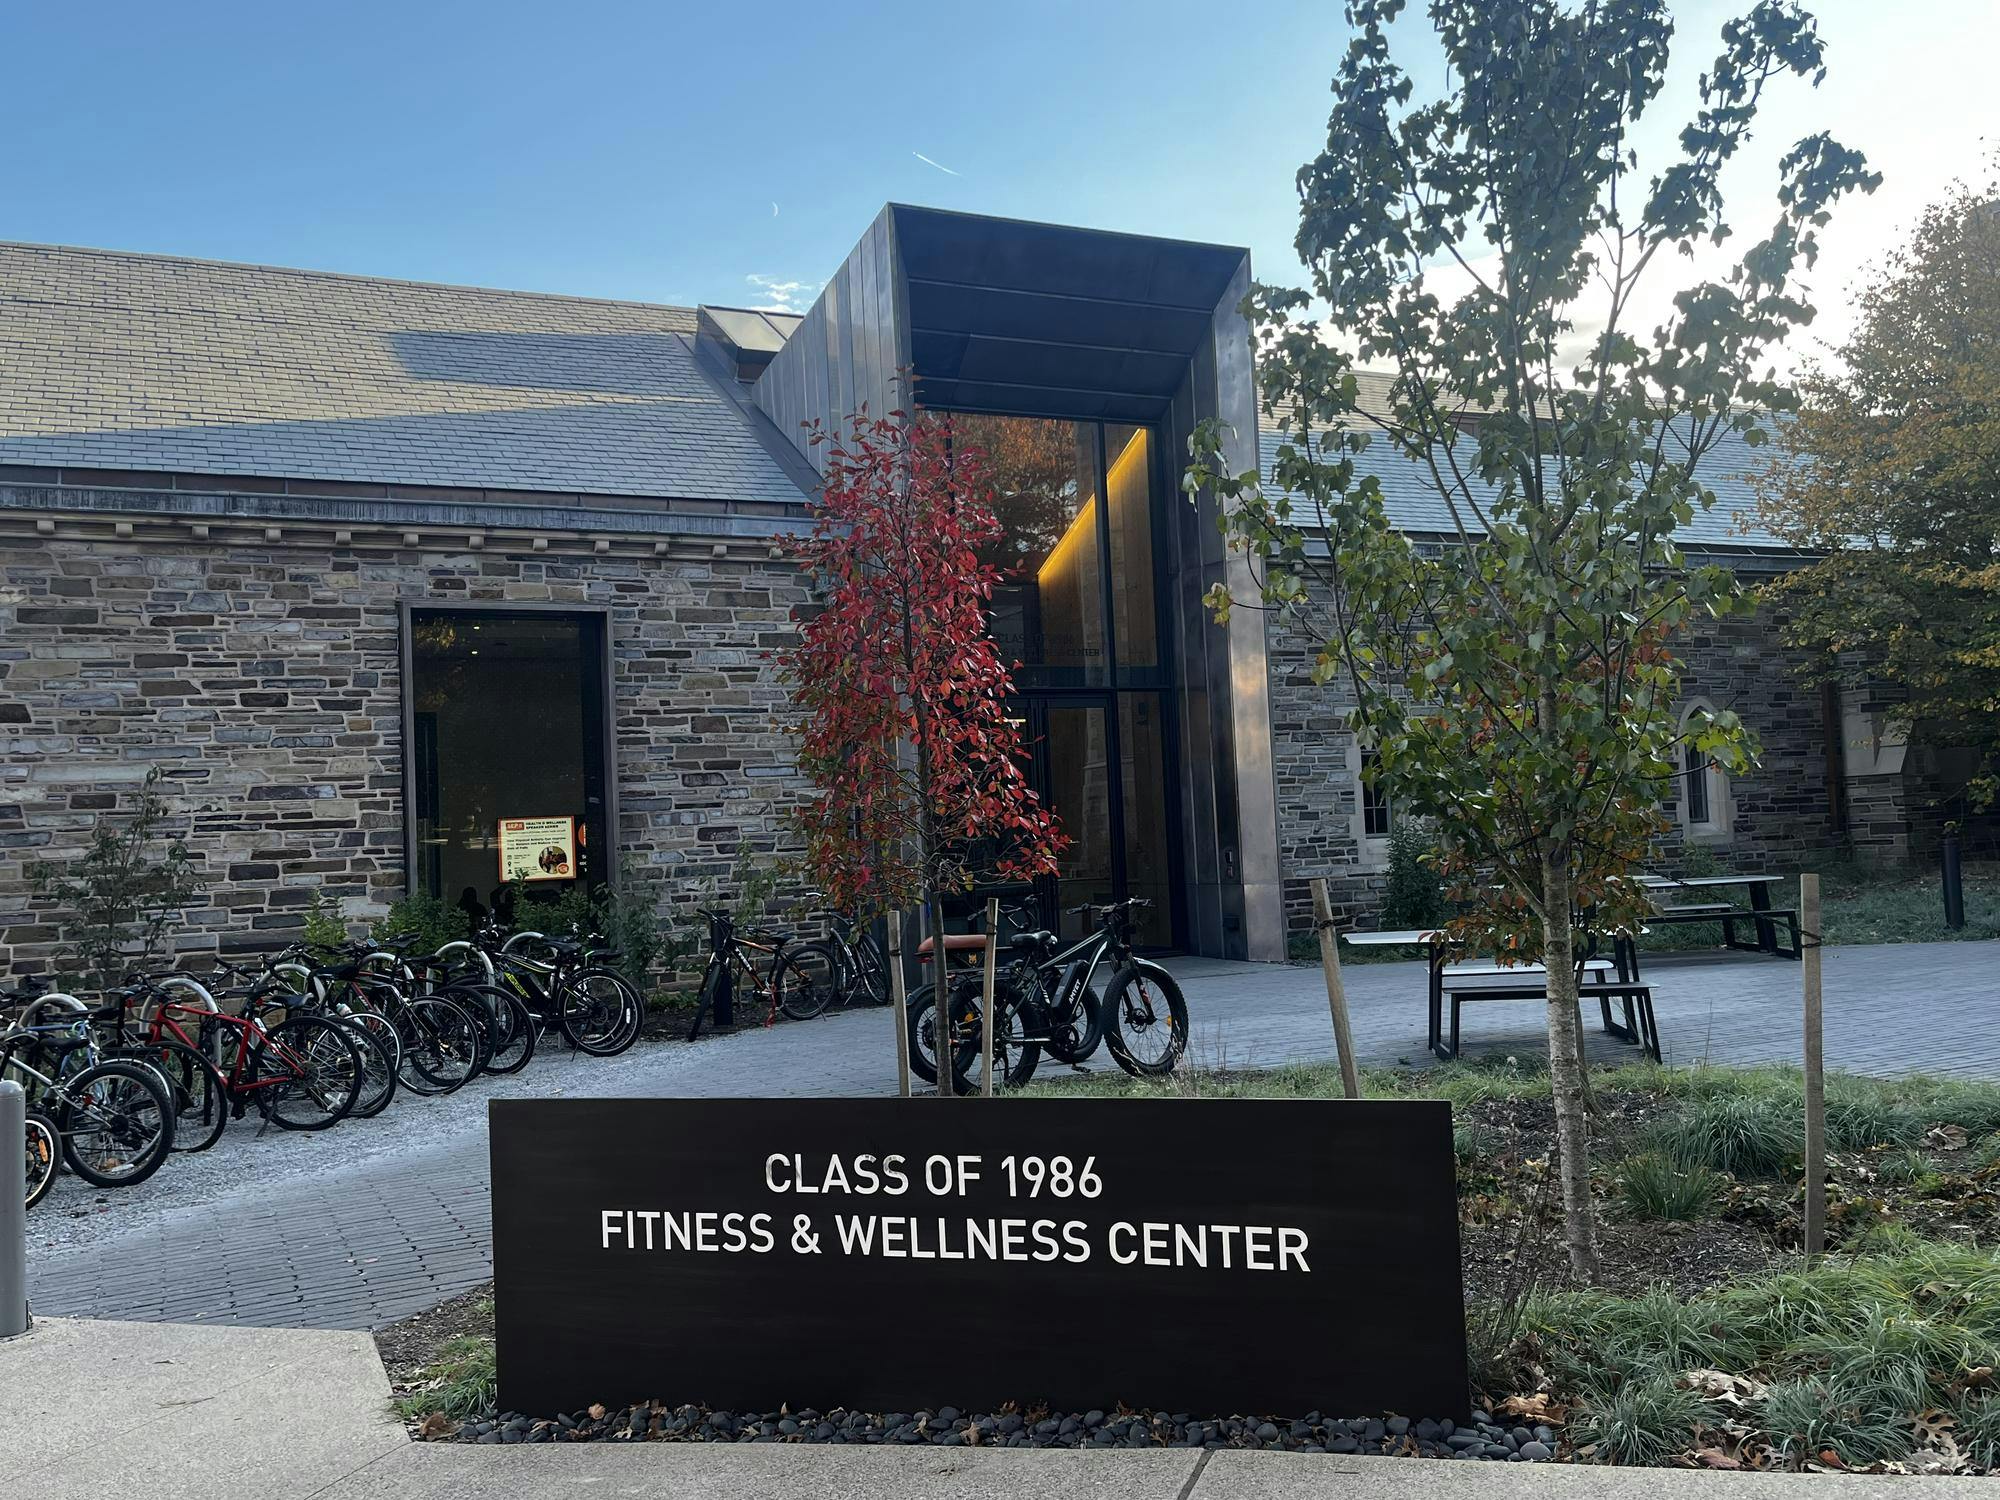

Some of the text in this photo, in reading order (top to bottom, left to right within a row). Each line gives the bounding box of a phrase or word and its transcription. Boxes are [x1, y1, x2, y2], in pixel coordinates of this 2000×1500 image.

[765, 1153, 1103, 1199] CLASS OF 1986
[601, 1210, 1311, 1273] FITNESS & WELLNESS CENTER
